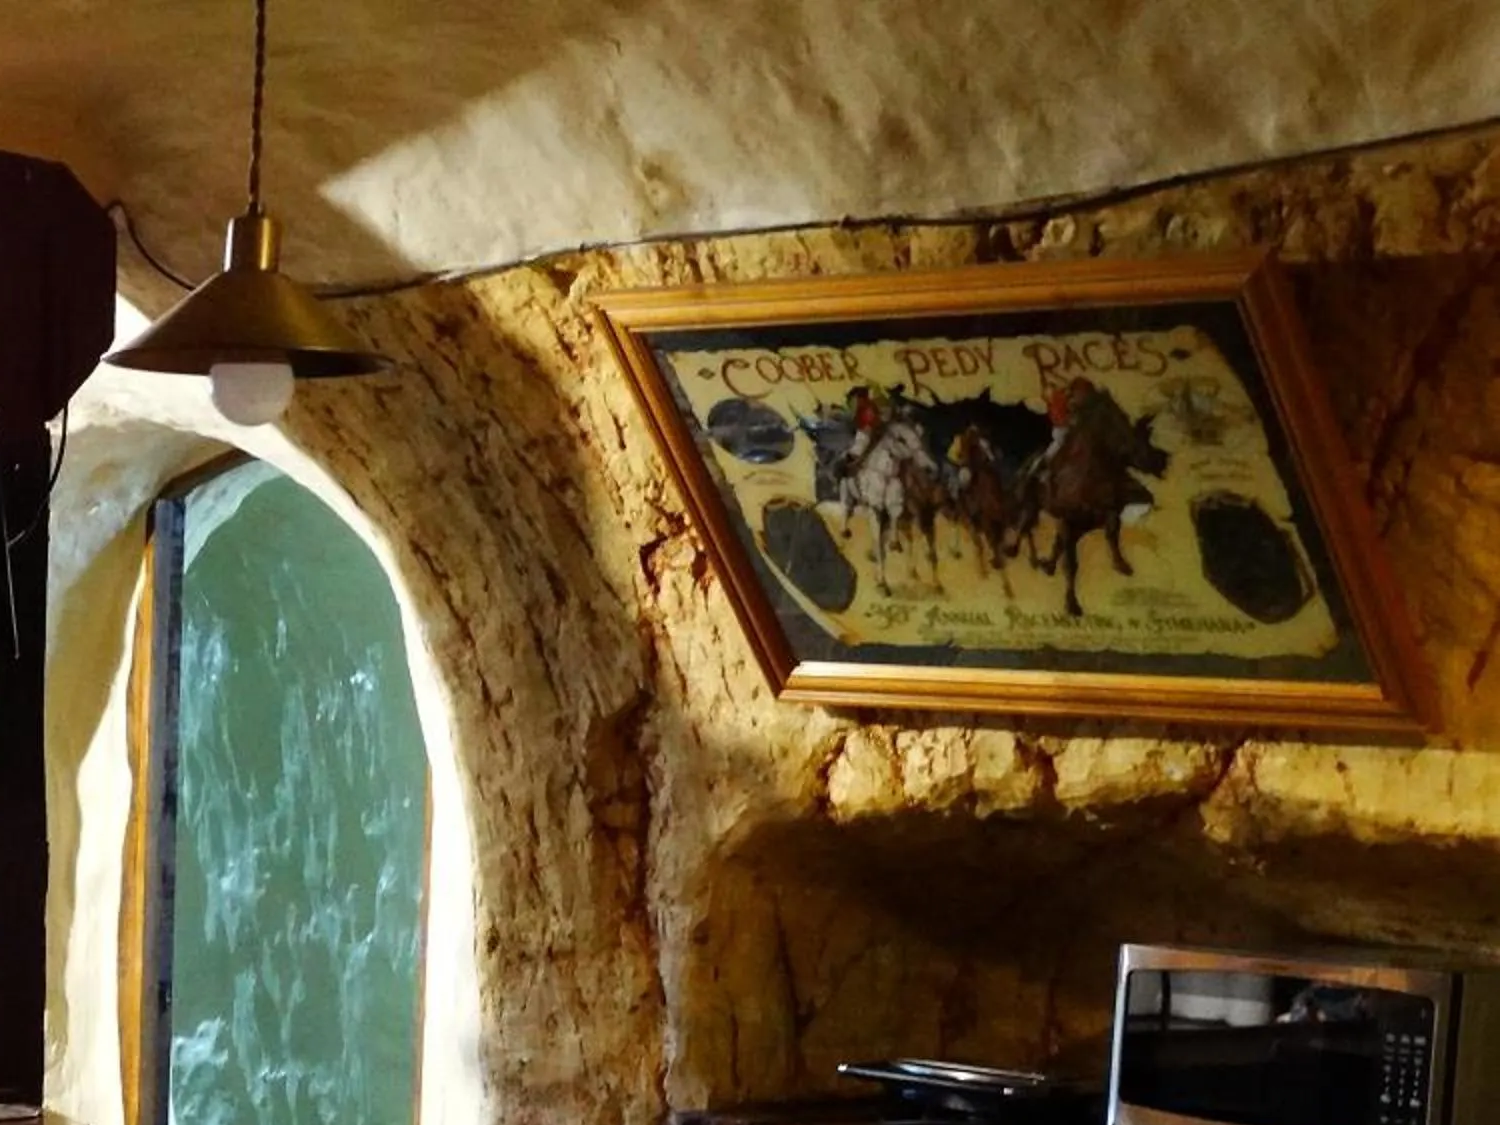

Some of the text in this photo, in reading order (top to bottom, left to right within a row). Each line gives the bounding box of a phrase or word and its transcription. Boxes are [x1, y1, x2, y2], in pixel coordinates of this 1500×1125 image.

[720, 338, 1168, 400] COOBER PEDY RACES
